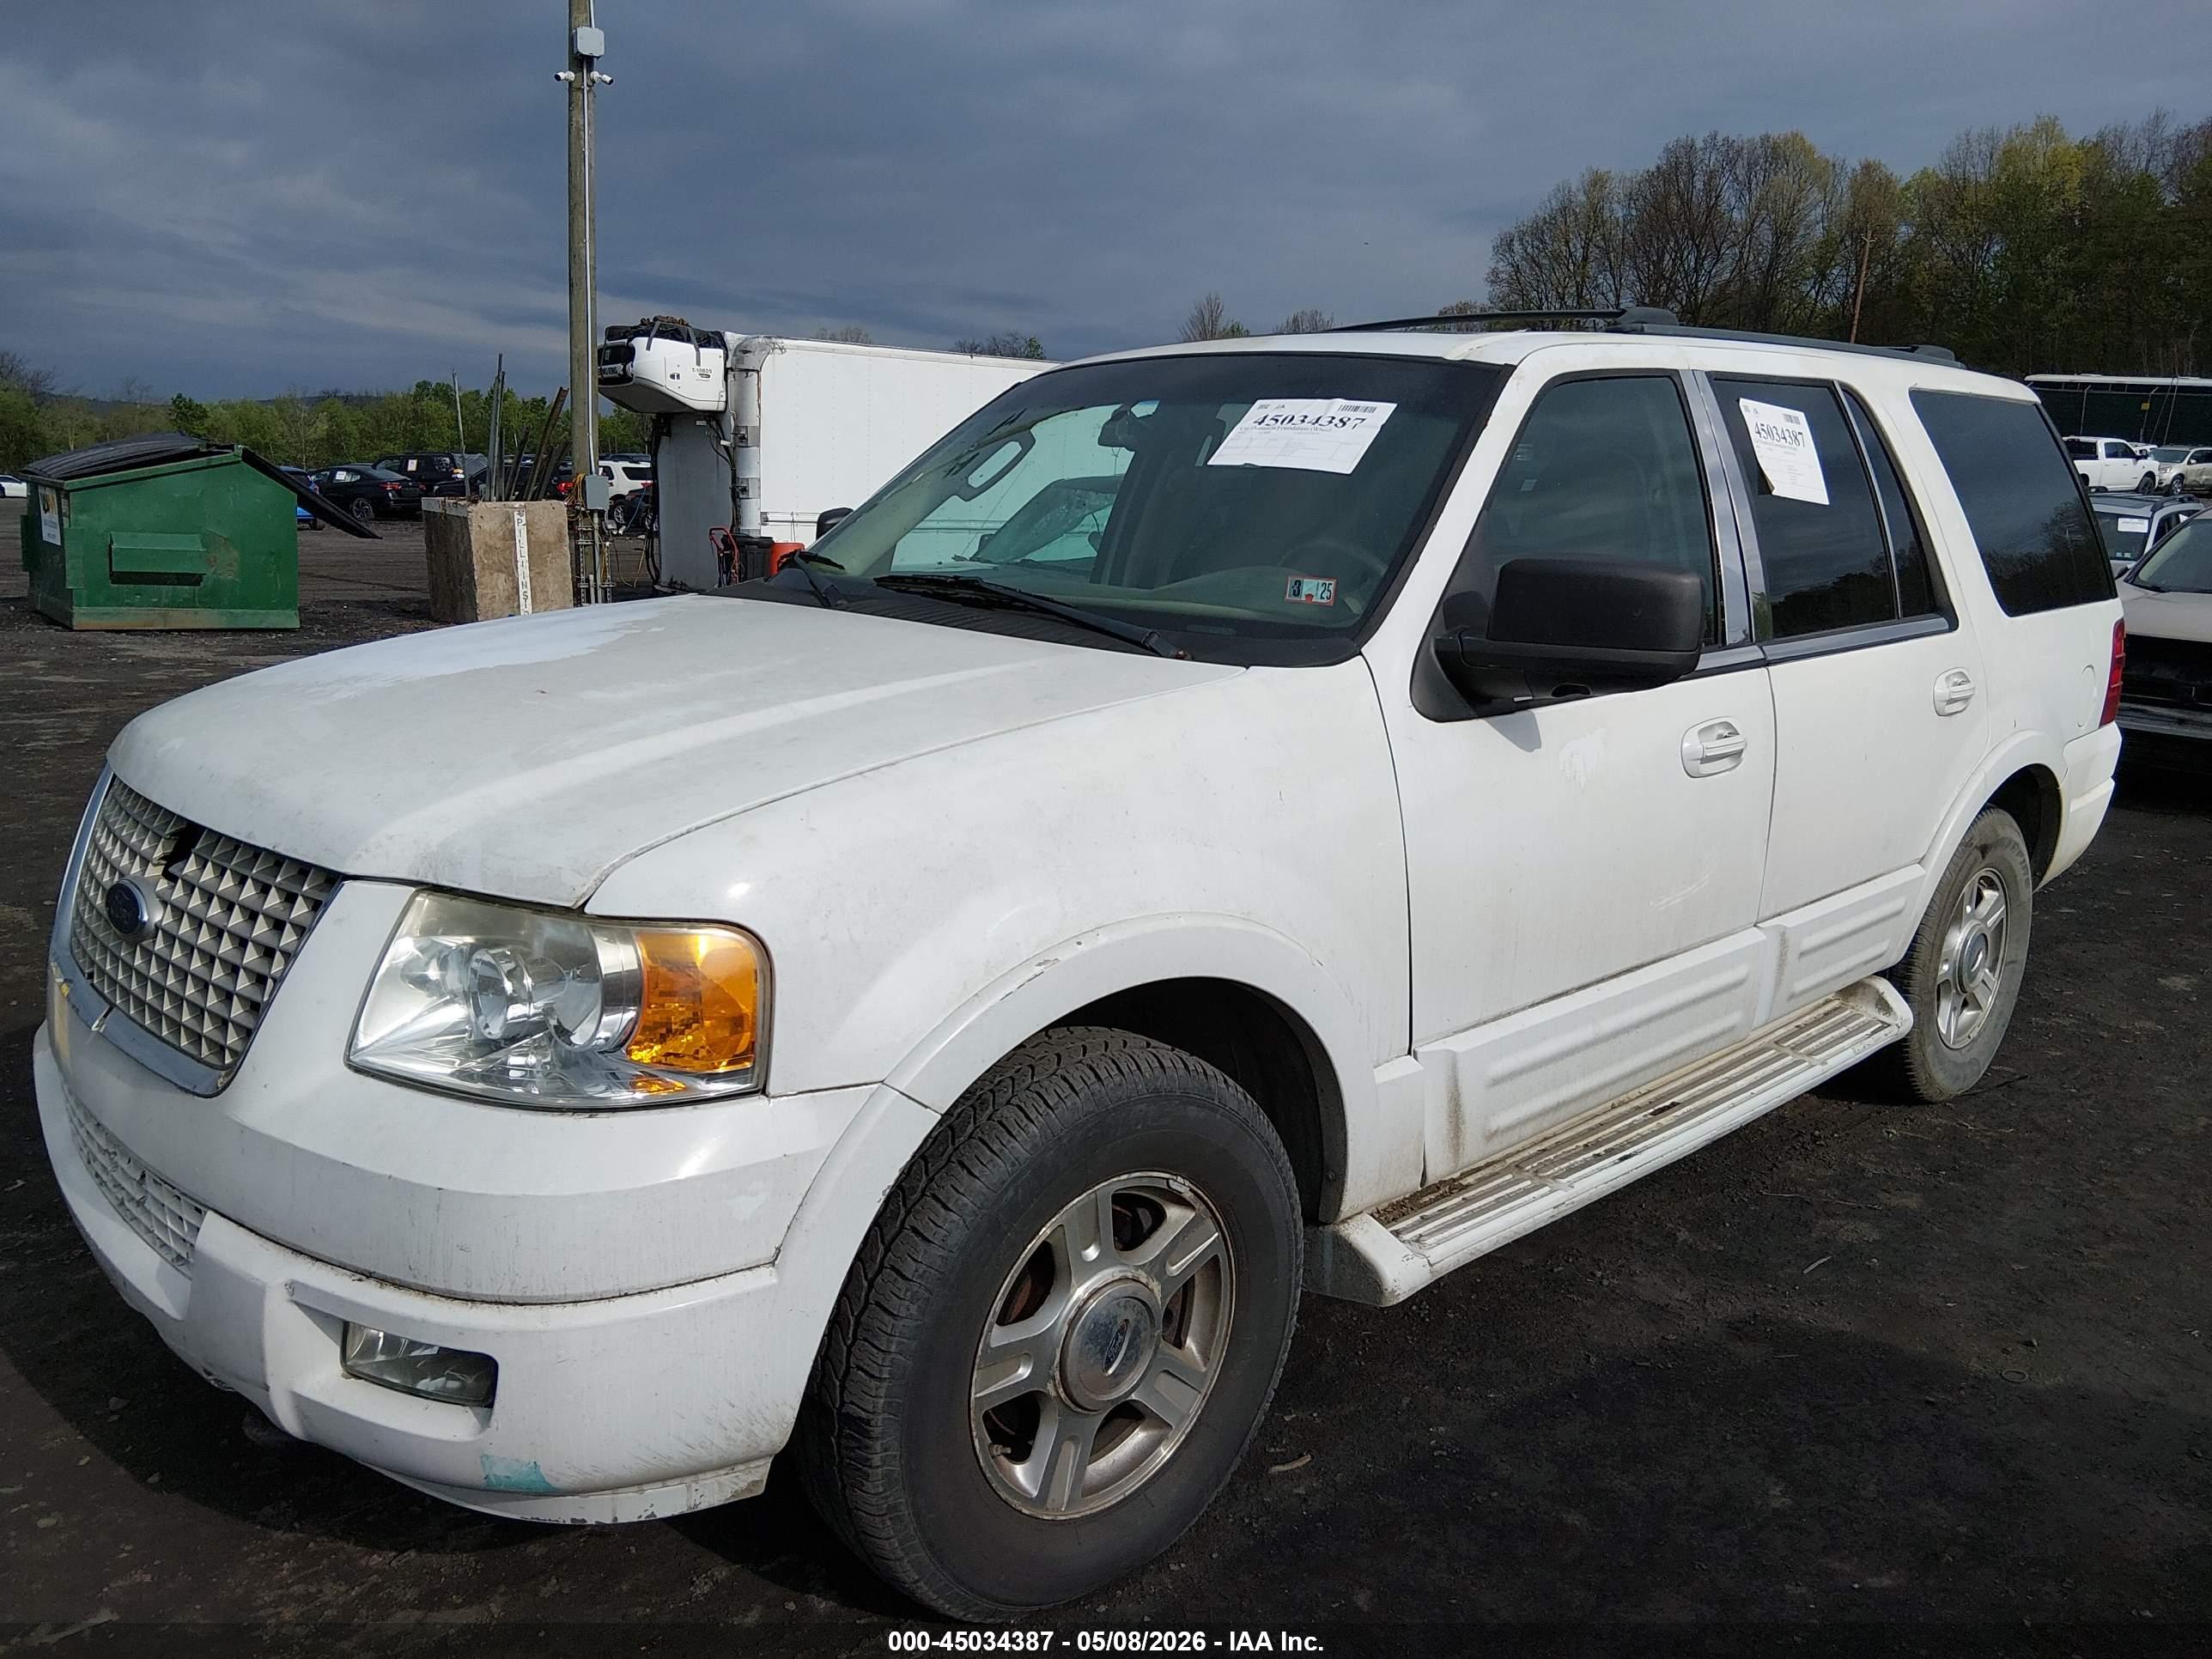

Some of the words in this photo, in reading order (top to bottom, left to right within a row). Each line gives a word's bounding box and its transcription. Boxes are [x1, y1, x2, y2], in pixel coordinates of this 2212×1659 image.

[1253, 413, 1367, 430] 45034387
[1754, 421, 1805, 447] 45034387
[1291, 580, 1302, 597] 3
[1320, 582, 1333, 600] 25
[1108, 1332, 1123, 1361] Ford
